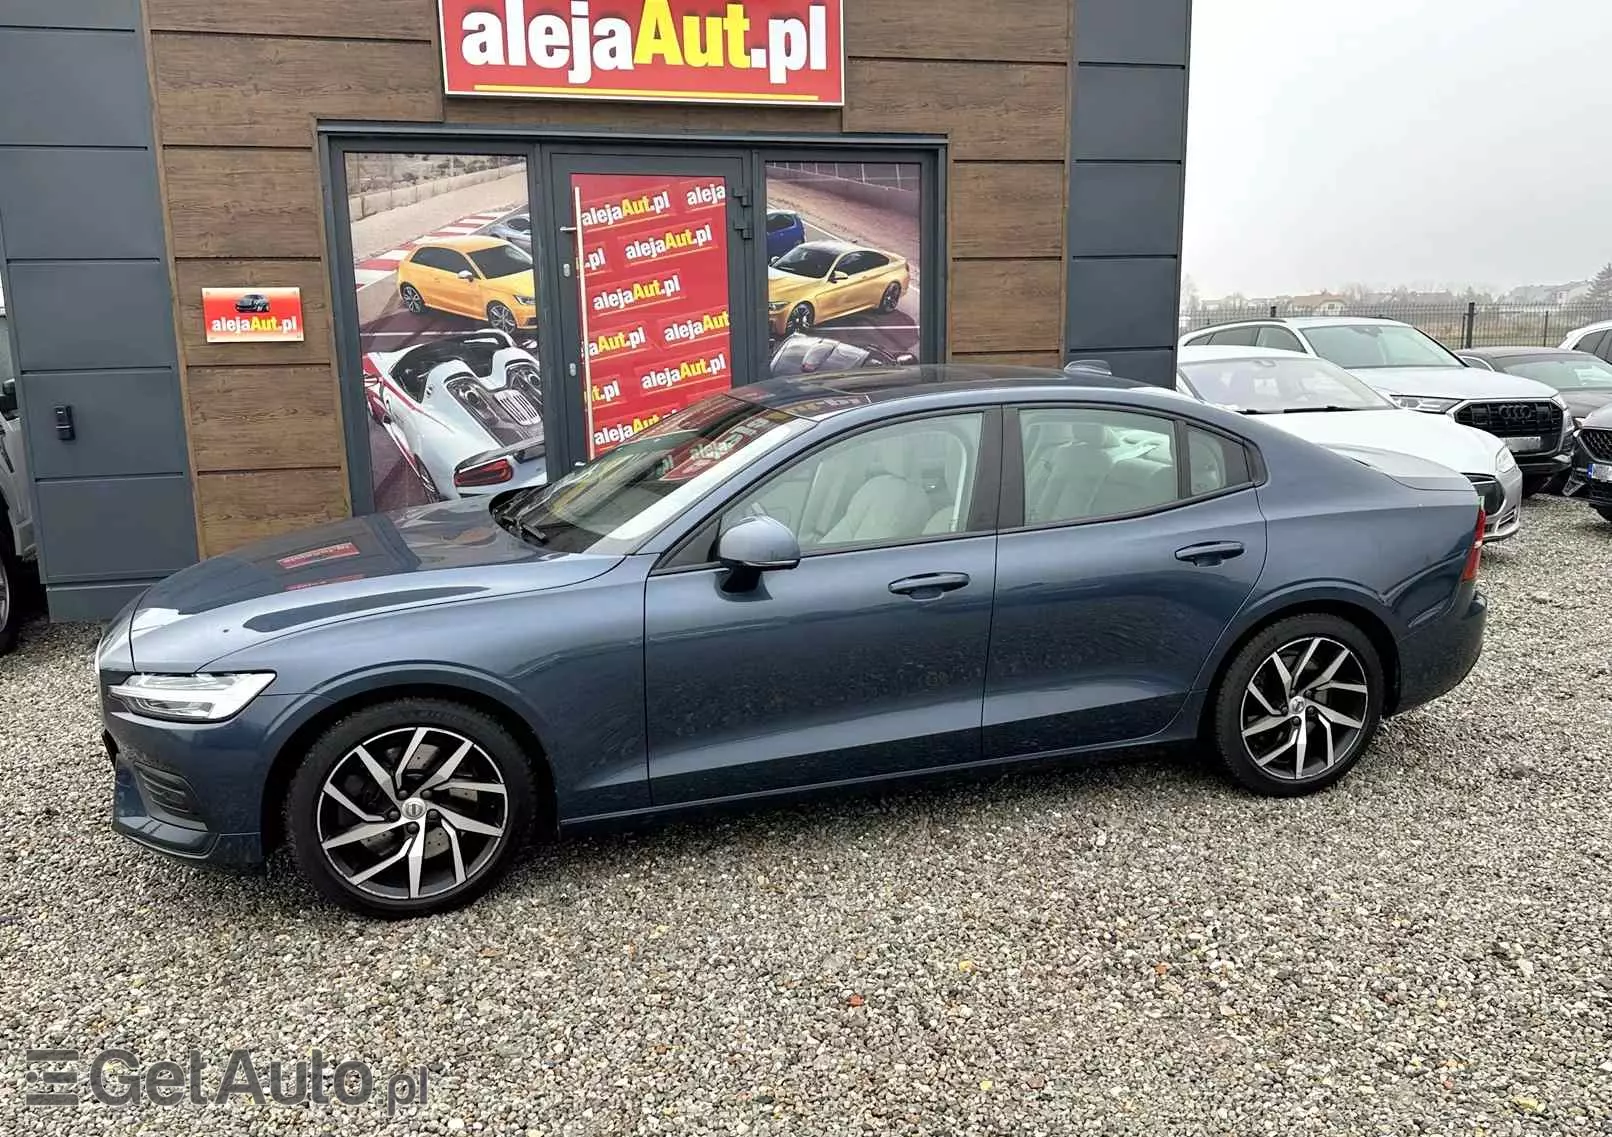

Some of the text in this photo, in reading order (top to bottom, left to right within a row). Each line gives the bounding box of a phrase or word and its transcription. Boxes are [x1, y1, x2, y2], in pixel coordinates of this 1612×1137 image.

[461, 0, 827, 84] alejaAut.pl
[581, 191, 670, 225] alejaAut.pl
[687, 183, 725, 206] aleja
[625, 224, 712, 259] alejaAut.pl
[593, 275, 680, 310] alejaAut.pl
[211, 315, 297, 334] alejaAut.pl
[664, 310, 729, 341] alejaAut
[641, 353, 726, 388] alejaAut.pl
